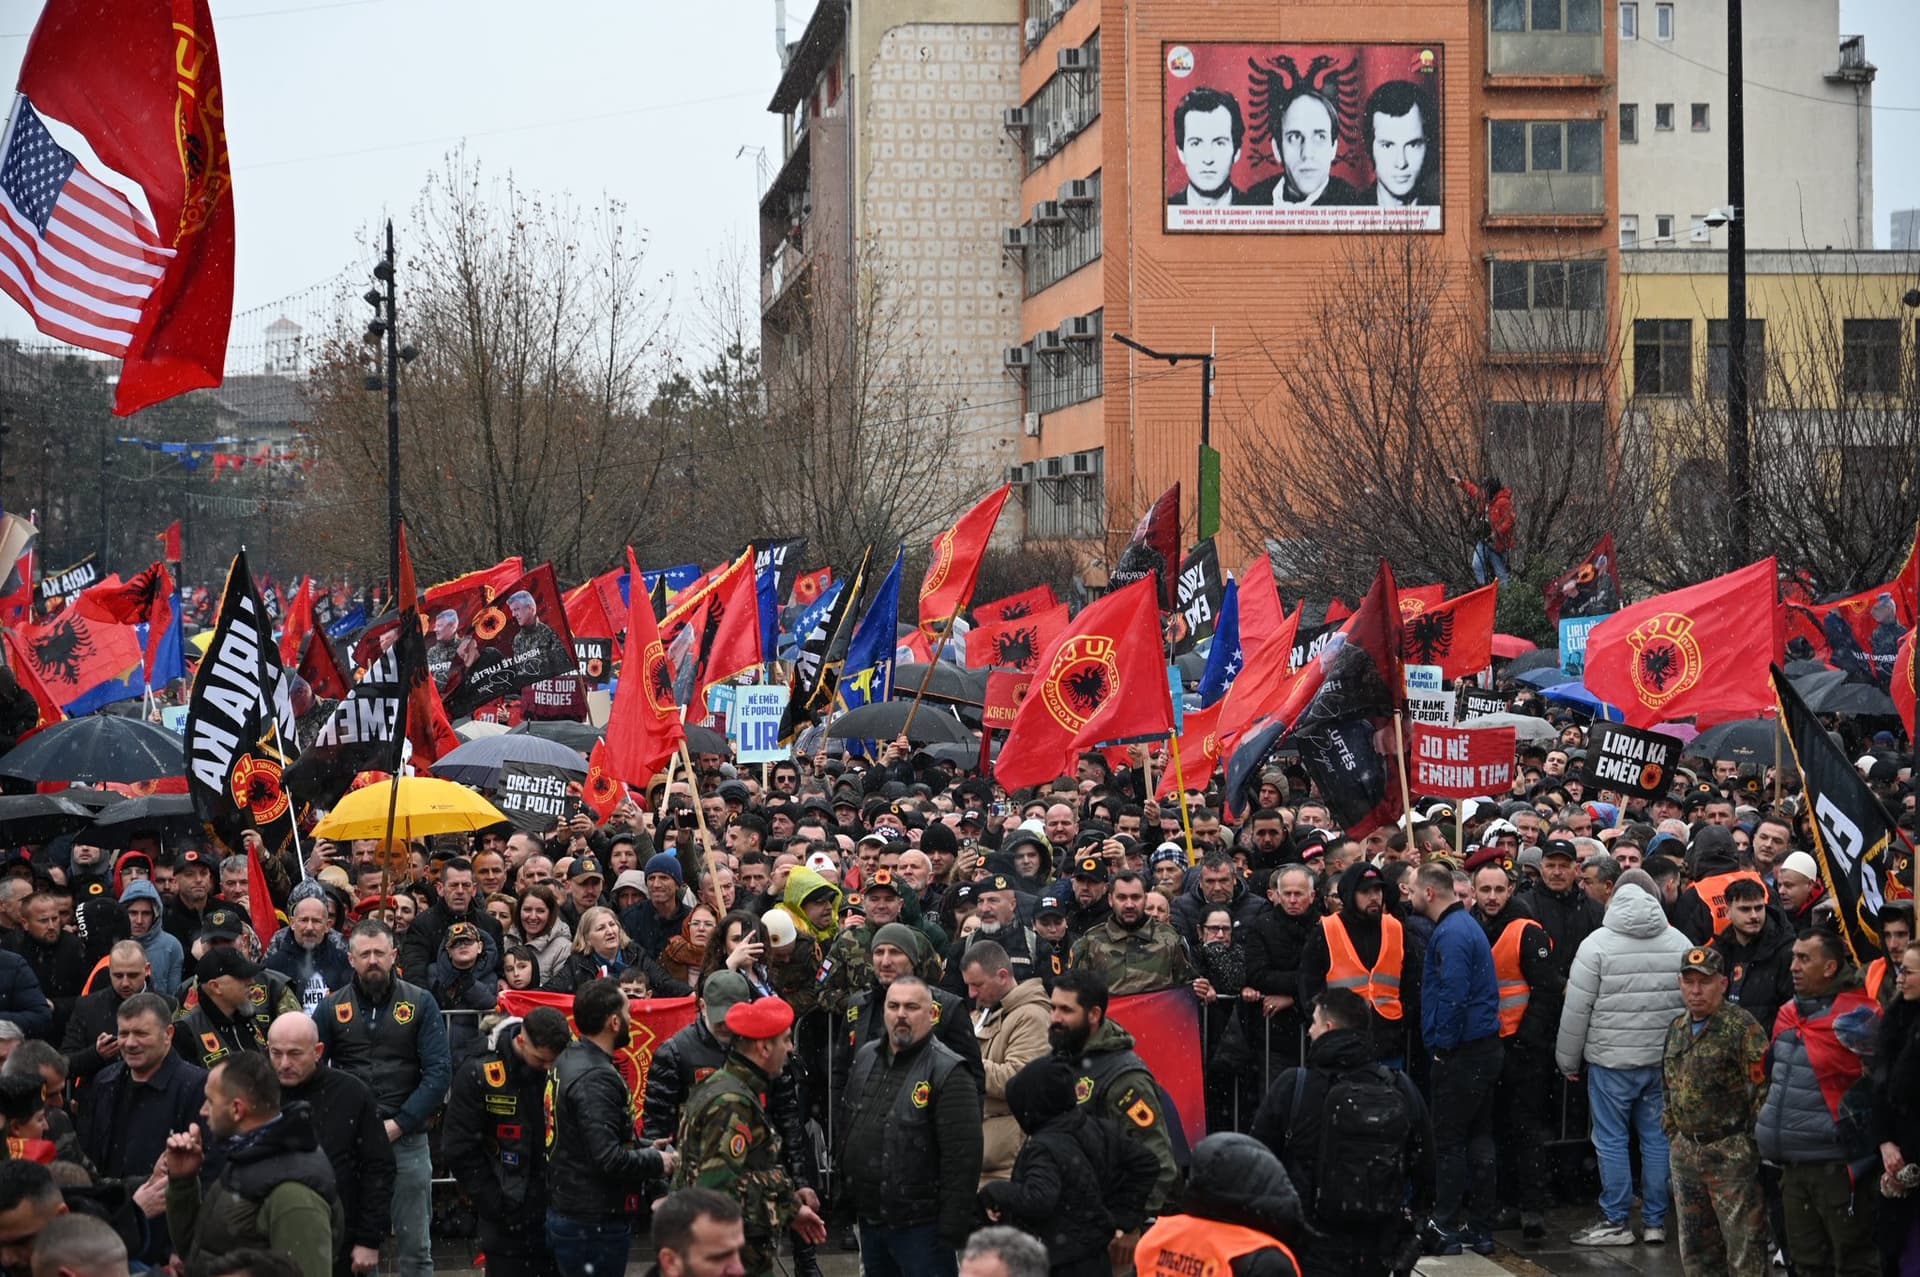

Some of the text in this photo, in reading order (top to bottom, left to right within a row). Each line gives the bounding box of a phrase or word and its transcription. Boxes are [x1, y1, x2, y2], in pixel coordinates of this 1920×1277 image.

[588, 645, 602, 659] KA
[555, 680, 576, 693] OUR
[534, 693, 572, 706] HEROES
[748, 692, 758, 705] NË
[759, 693, 779, 705] EMËR
[1422, 700, 1445, 711] NAME
[741, 704, 751, 716] TË
[1418, 712, 1449, 723] PEOPLE
[741, 721, 787, 752] LIR
[1419, 734, 1470, 761] JO NË
[1602, 730, 1667, 765] LIRIA KA
[1418, 762, 1509, 788] EMRIN TIM
[1595, 756, 1641, 786] EMËR
[506, 774, 565, 797] DREJTËSI
[503, 793, 566, 816] JO POLITI
